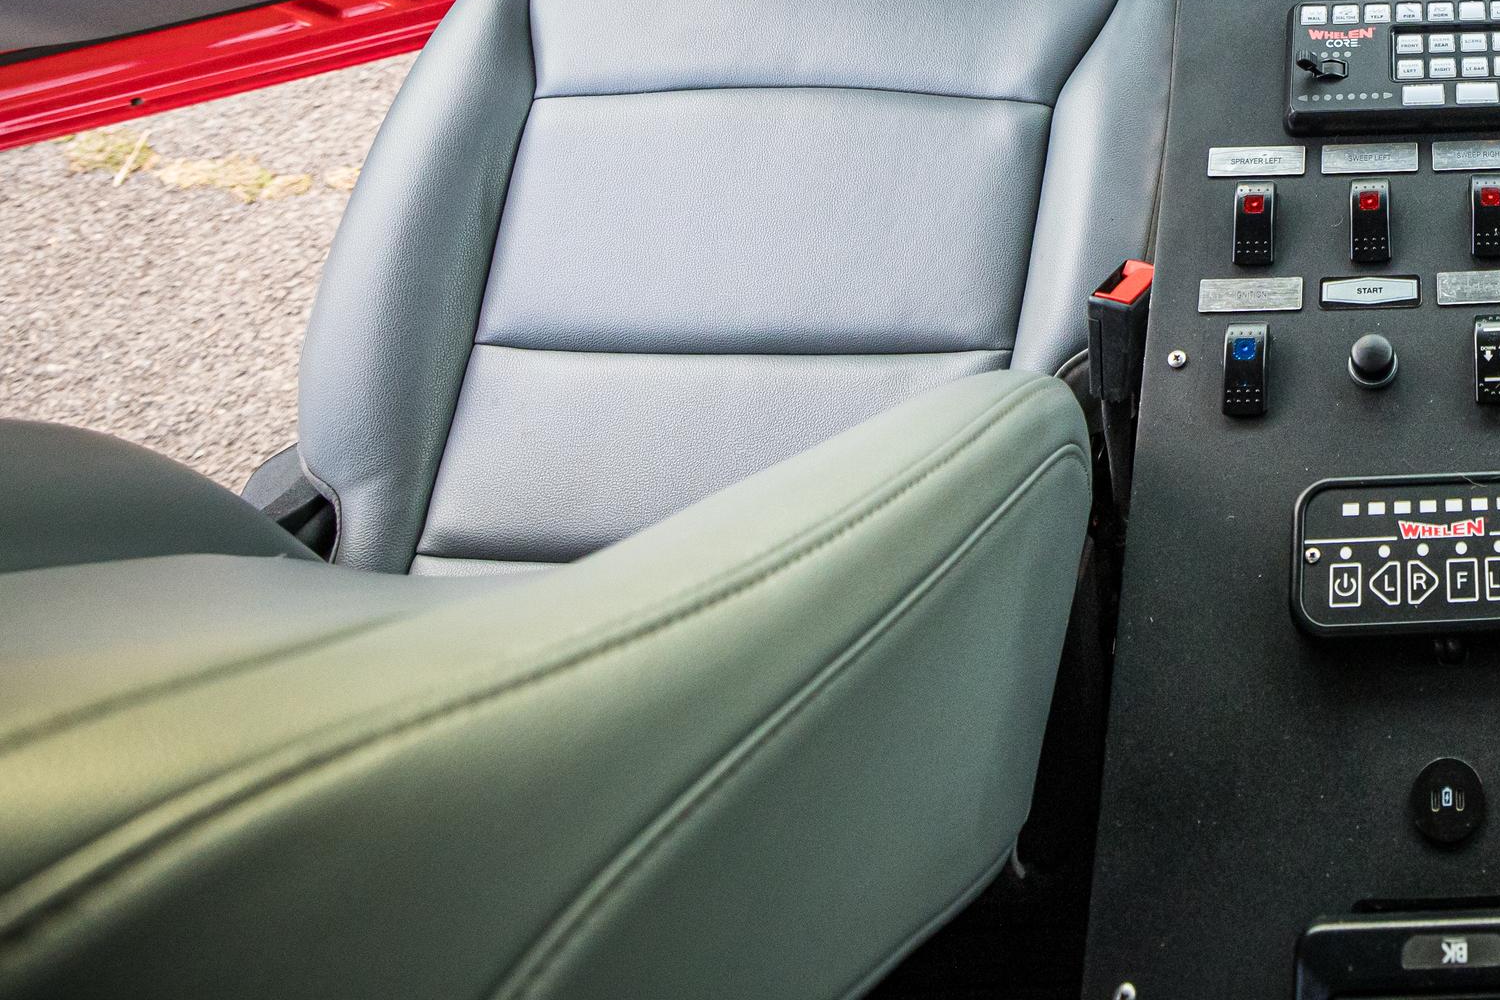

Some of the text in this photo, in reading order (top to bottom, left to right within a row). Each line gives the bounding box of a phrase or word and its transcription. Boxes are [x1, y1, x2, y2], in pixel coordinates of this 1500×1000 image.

[1308, 27, 1373, 40] WHELEN
[1325, 39, 1359, 48] CORE
[1230, 157, 1282, 166] SPRAYER LEFT
[1348, 154, 1373, 162] SWEEP
[1456, 151, 1481, 159] SWEEP
[1356, 286, 1384, 295] START
[1398, 517, 1485, 539] WHELEN
[1384, 575, 1395, 592] L
[1413, 573, 1427, 591] R
[1456, 572, 1468, 589] F
[1441, 941, 1468, 964] BK
